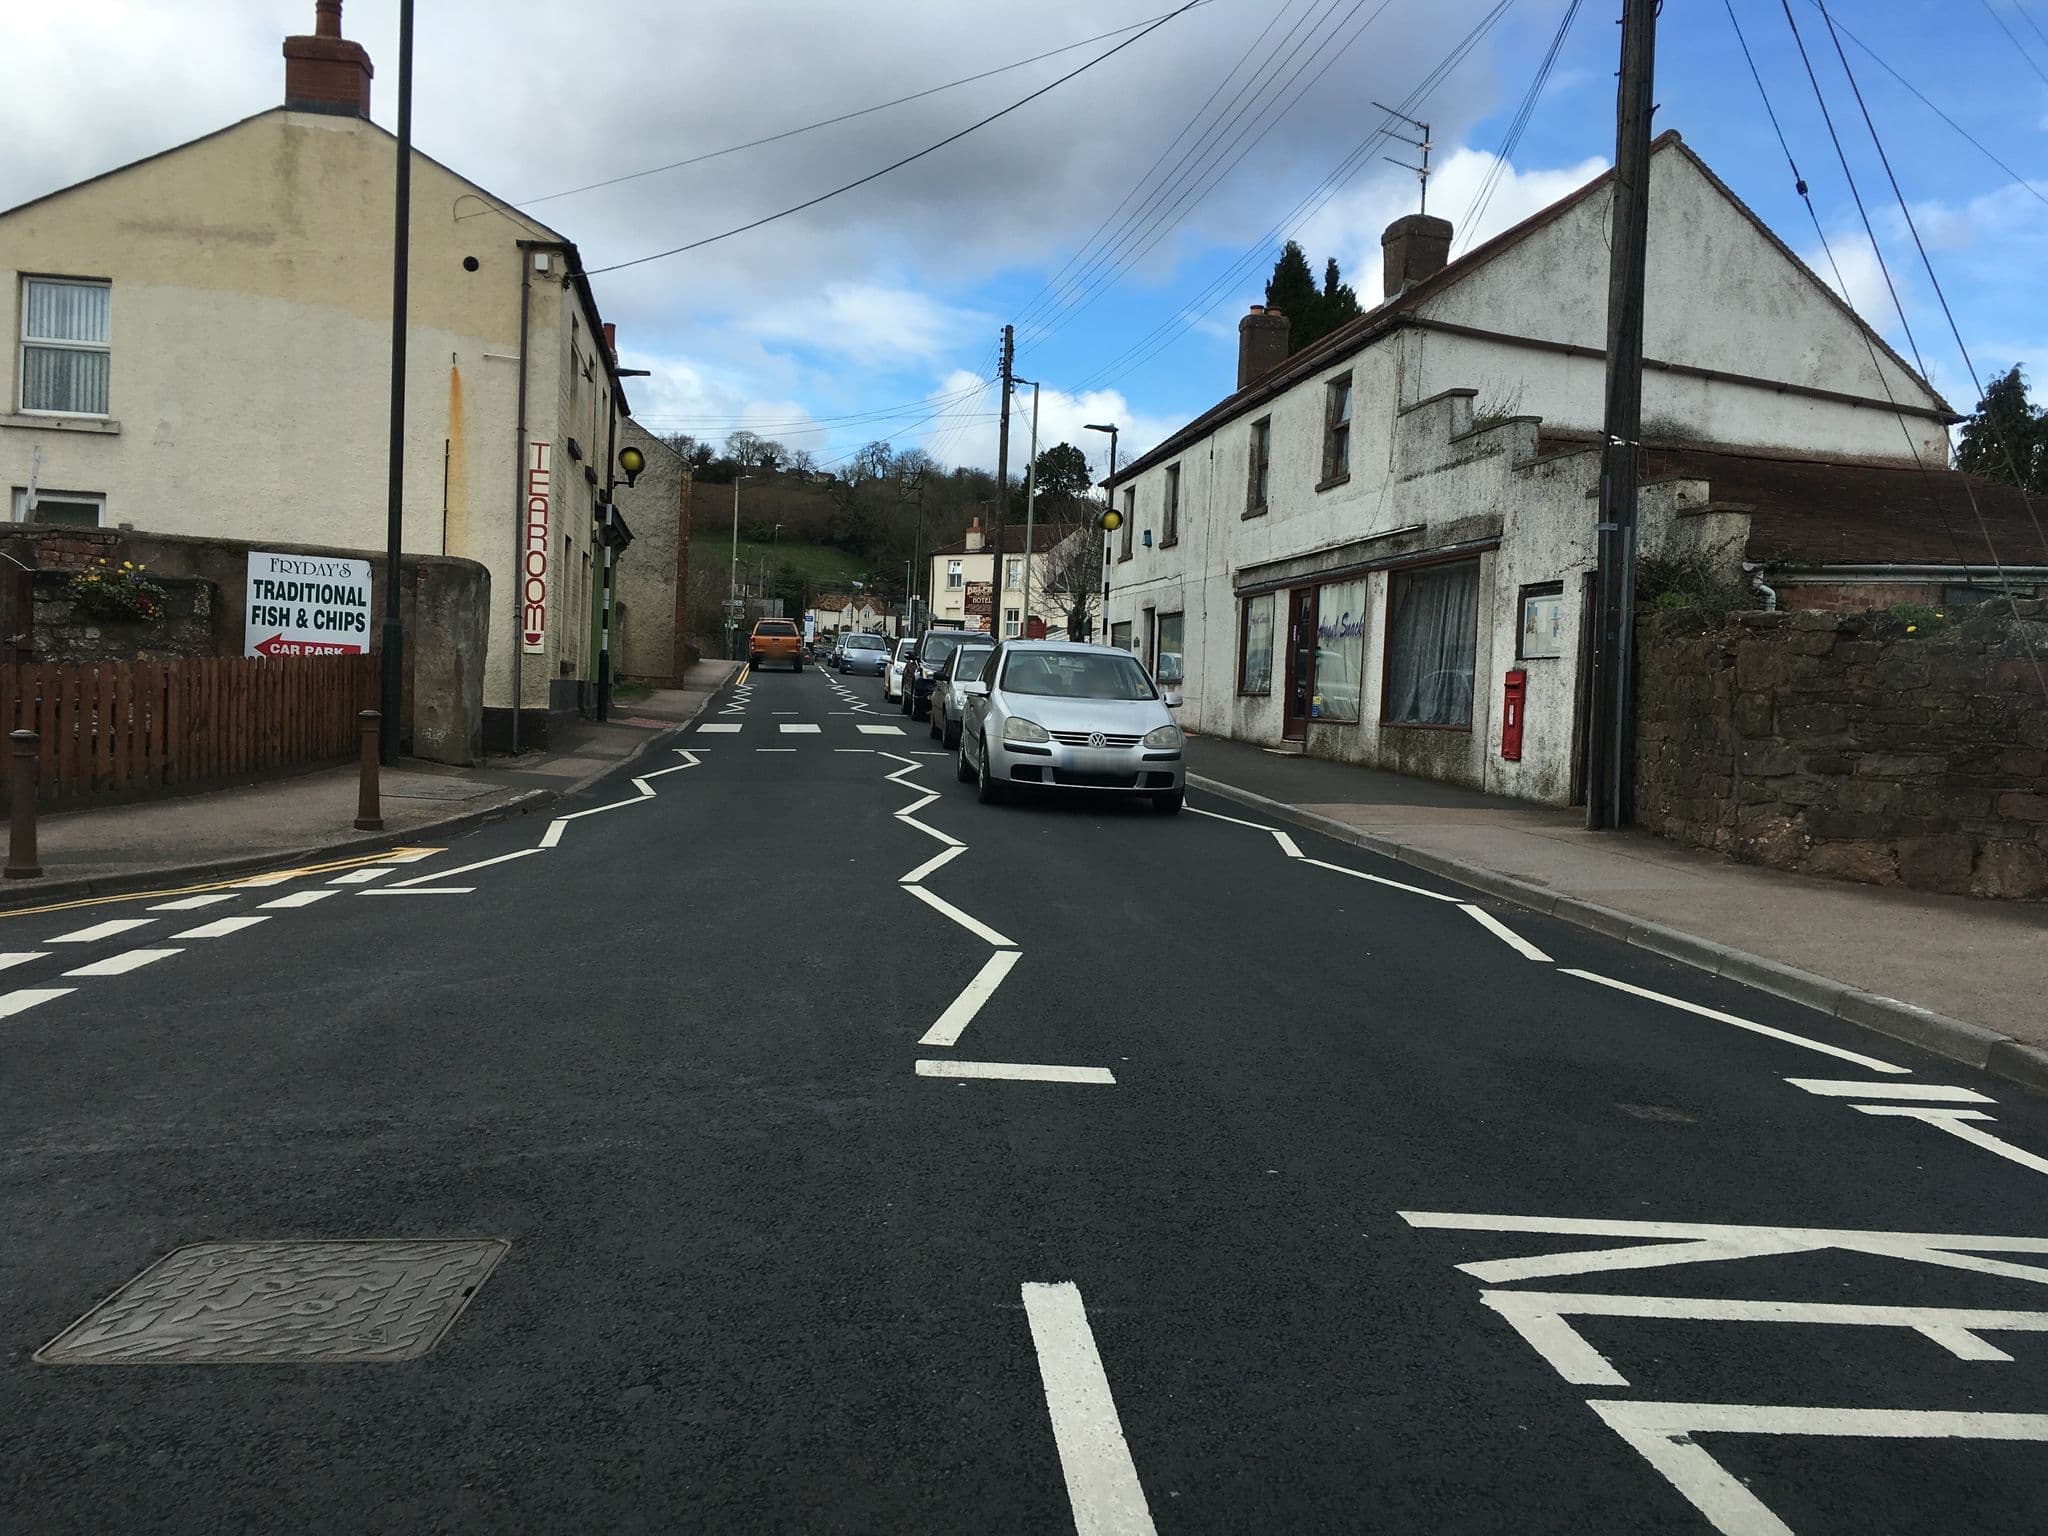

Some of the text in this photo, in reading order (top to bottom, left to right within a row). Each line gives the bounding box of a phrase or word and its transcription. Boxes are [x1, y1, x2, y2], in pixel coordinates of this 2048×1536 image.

[270, 557, 352, 579] FRYDAY'S
[252, 578, 367, 608] TRADITIONAL
[251, 604, 366, 633] FISH & CHIPS
[269, 642, 345, 657] CAR PARK
